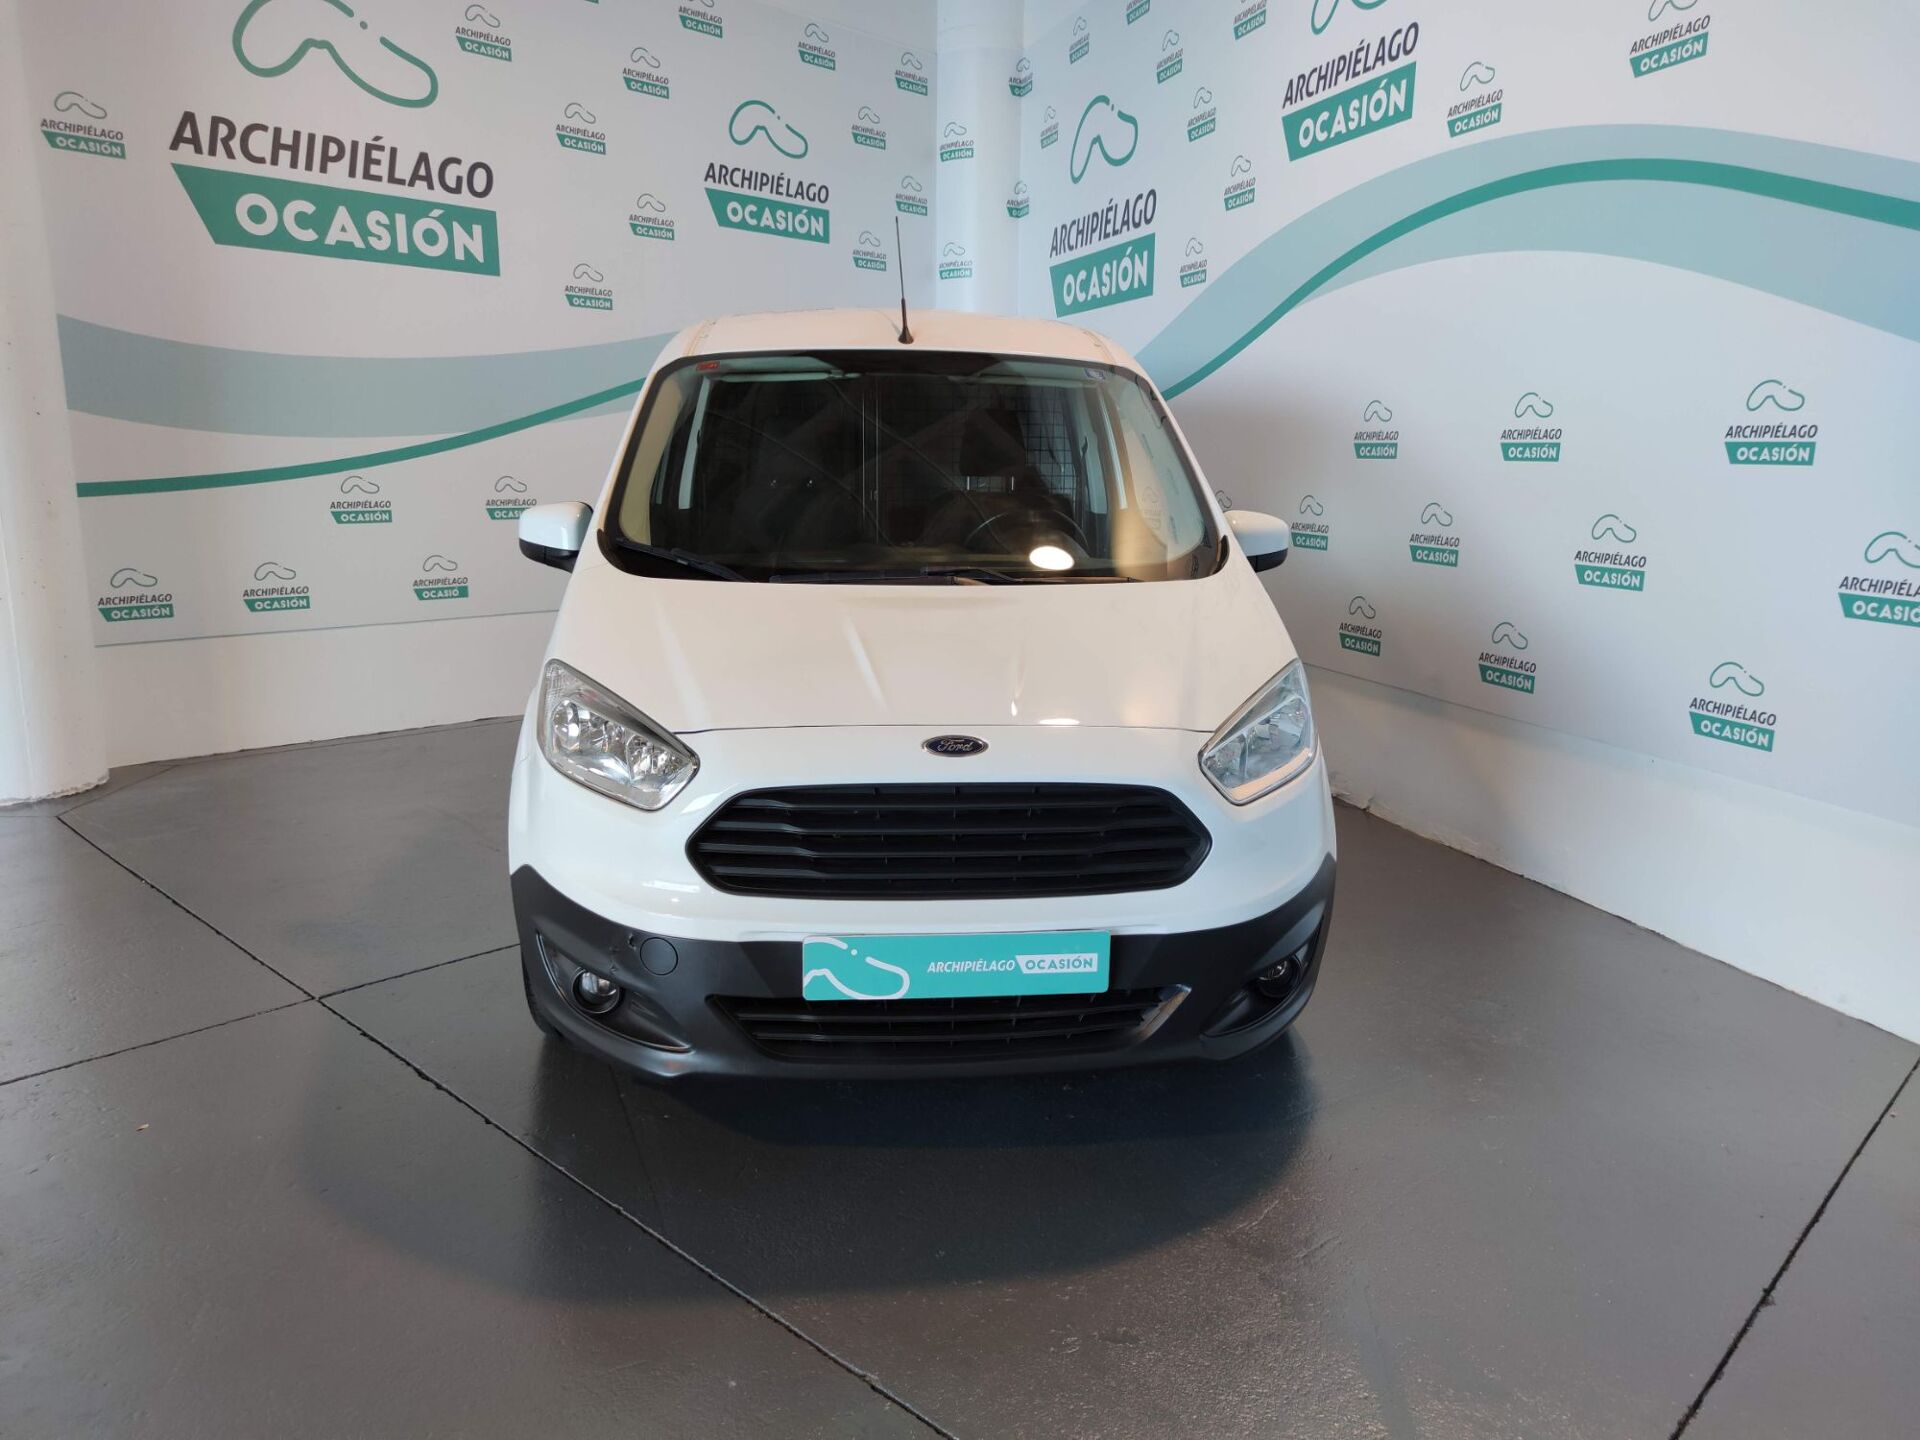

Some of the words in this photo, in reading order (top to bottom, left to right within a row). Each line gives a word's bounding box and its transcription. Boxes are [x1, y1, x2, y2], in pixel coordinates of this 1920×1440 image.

[685, 19, 720, 35] OCASIÓN
[1630, 14, 1711, 55] ARCHIPIÉLAGO
[464, 42, 509, 60] OCASIÓN
[1639, 38, 1704, 73] OCASIÓN
[1282, 22, 1419, 108] ARCHIPIÉLAGO
[630, 81, 667, 97] OCASIÓN
[1447, 89, 1503, 118] ARCHIPIÉLAGO
[1299, 79, 1407, 148] OCASIÓN
[1454, 108, 1499, 134] OCASIÓN
[55, 136, 123, 158] OCASIÓN
[563, 138, 603, 152] OCASIÓN
[169, 113, 493, 197] ARCHIPIÉLAGO
[704, 162, 829, 204] ARCHIPIÉLAGO
[727, 200, 822, 238] OCASIÓN
[1050, 188, 1157, 258] ARCHIPIÉLAGO
[235, 193, 485, 264] OCASIÓN
[636, 225, 673, 239] OCASIÓN
[1063, 246, 1148, 306] OCASIÓN
[572, 298, 611, 309] OCASIÓN
[1354, 430, 1399, 441] ARCHIPIÉLAGO
[1500, 428, 1562, 440] ARCHIPIÉLAGO
[1724, 421, 1818, 439] ARCHIPIÉLAGO
[1359, 445, 1395, 457] OCASIÓN
[1508, 446, 1557, 459] OCASIÓN
[1736, 444, 1810, 463] OCASIÓN
[330, 500, 391, 509] ARCHIPIÉLAGO
[486, 498, 537, 507] ARCHIPIÉLAGO
[341, 510, 389, 522] OCASIÓN
[1291, 522, 1329, 534] ARCHIPIÉLAGO
[1296, 535, 1326, 549] OCASIÓN
[1409, 532, 1460, 548] ARCHIPIÉLAGO
[1416, 550, 1457, 565] OCASIÓN
[1574, 550, 1646, 568] ARCHIPIÉLAGO
[413, 576, 468, 587] ARCHIPIÉLAGO
[1583, 568, 1641, 588] OCASIÓN
[97, 593, 172, 606] ARCHIPIÉLAGO
[243, 586, 309, 598] ARCHIPIÉLAGO
[255, 597, 306, 609] OCASIÓN
[111, 605, 170, 619] OCASIÓN
[1339, 622, 1382, 639] ARCHIPIÉLAGO
[1344, 637, 1379, 653] OCASIÓN
[1478, 652, 1537, 674] ARCHIPIÉLAGO
[1486, 671, 1532, 692] OCASIÓN
[1690, 697, 1777, 728] ARCHIPIÉLAGO
[1700, 720, 1769, 749] OCASIÓN
[937, 740, 974, 752] Ford
[927, 957, 1015, 974] ARCHIPIÉLAGO
[1024, 956, 1093, 970] OCASIÓN
